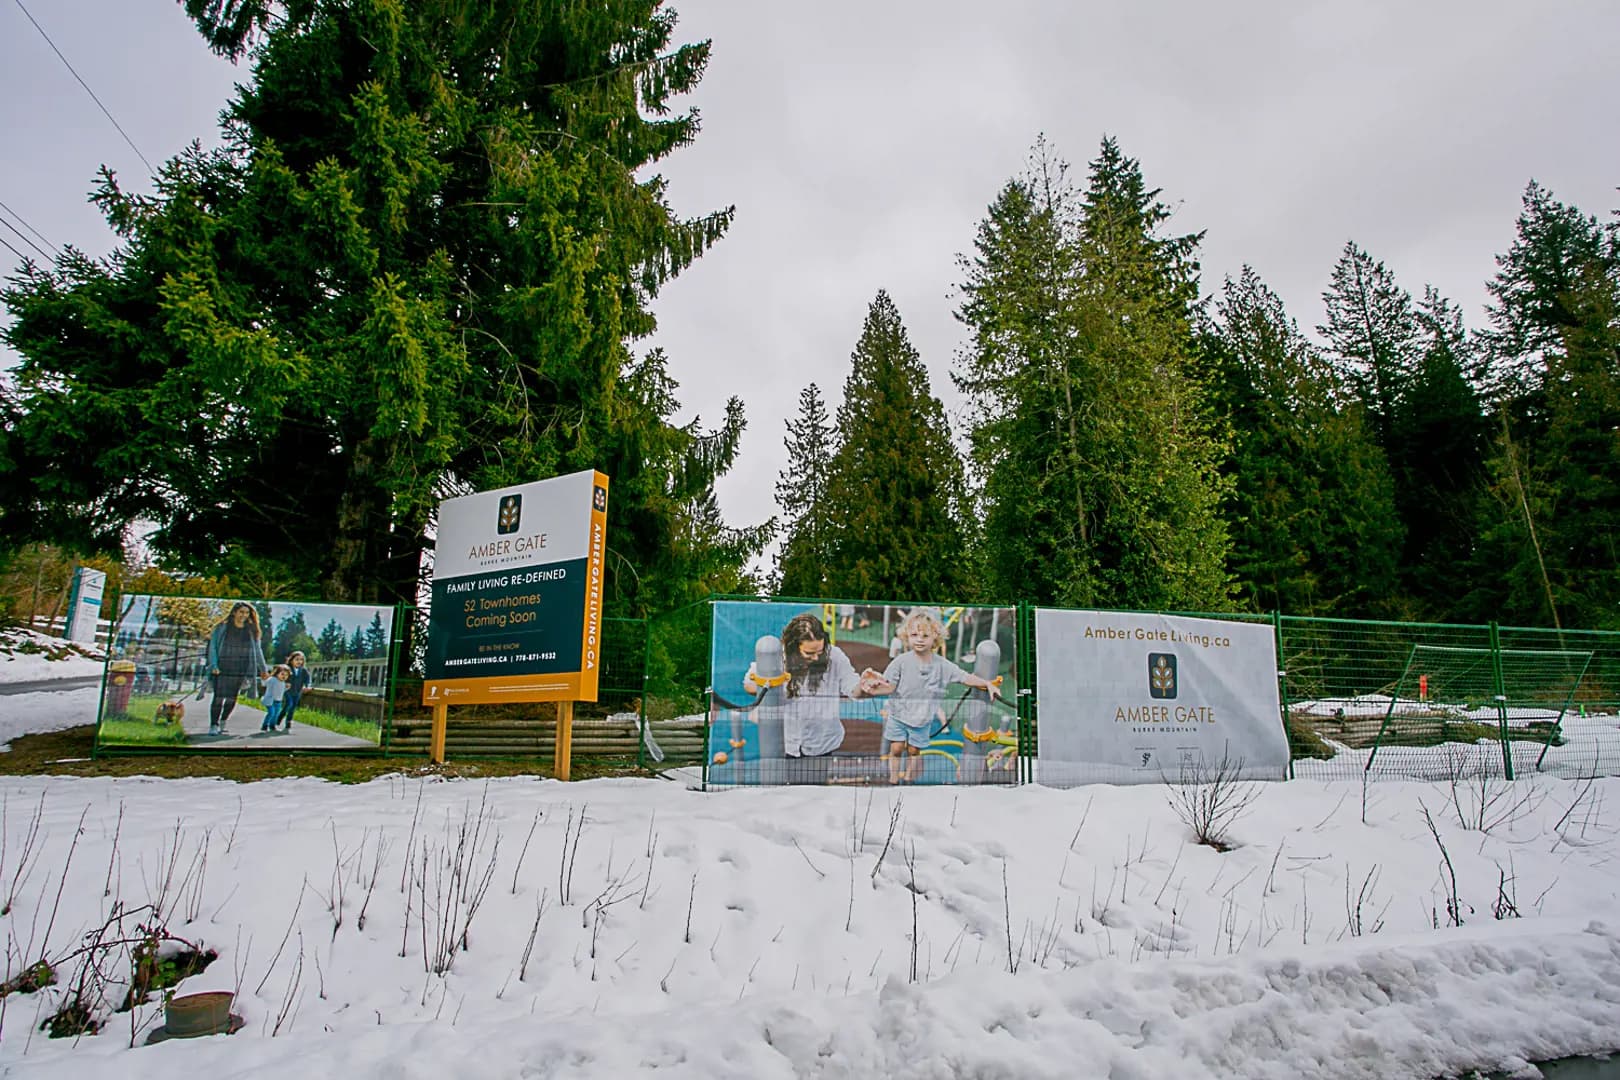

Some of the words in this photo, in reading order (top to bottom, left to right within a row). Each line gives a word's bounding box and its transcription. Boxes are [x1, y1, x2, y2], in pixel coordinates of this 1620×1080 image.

[469, 540, 511, 560] AMBER
[515, 533, 547, 552] GATE
[446, 580, 476, 594] FAMILY
[478, 576, 509, 590] LIVING
[511, 568, 567, 585] RE-DEFINED
[464, 600, 476, 612] 52
[480, 594, 541, 610] Townhomes
[587, 523, 601, 670] AMBERGATELIVING.CA
[466, 612, 507, 628] Coming
[509, 611, 537, 623] Soon
[1084, 626, 1131, 640] Amber
[1135, 628, 1168, 641] Gate
[1171, 630, 1230, 647] Living.ca
[445, 655, 507, 666] AMBERGATELIVING.CA
[312, 666, 341, 684] CREEK
[1114, 706, 1169, 723] AMBER
[1174, 706, 1216, 723] GATE
